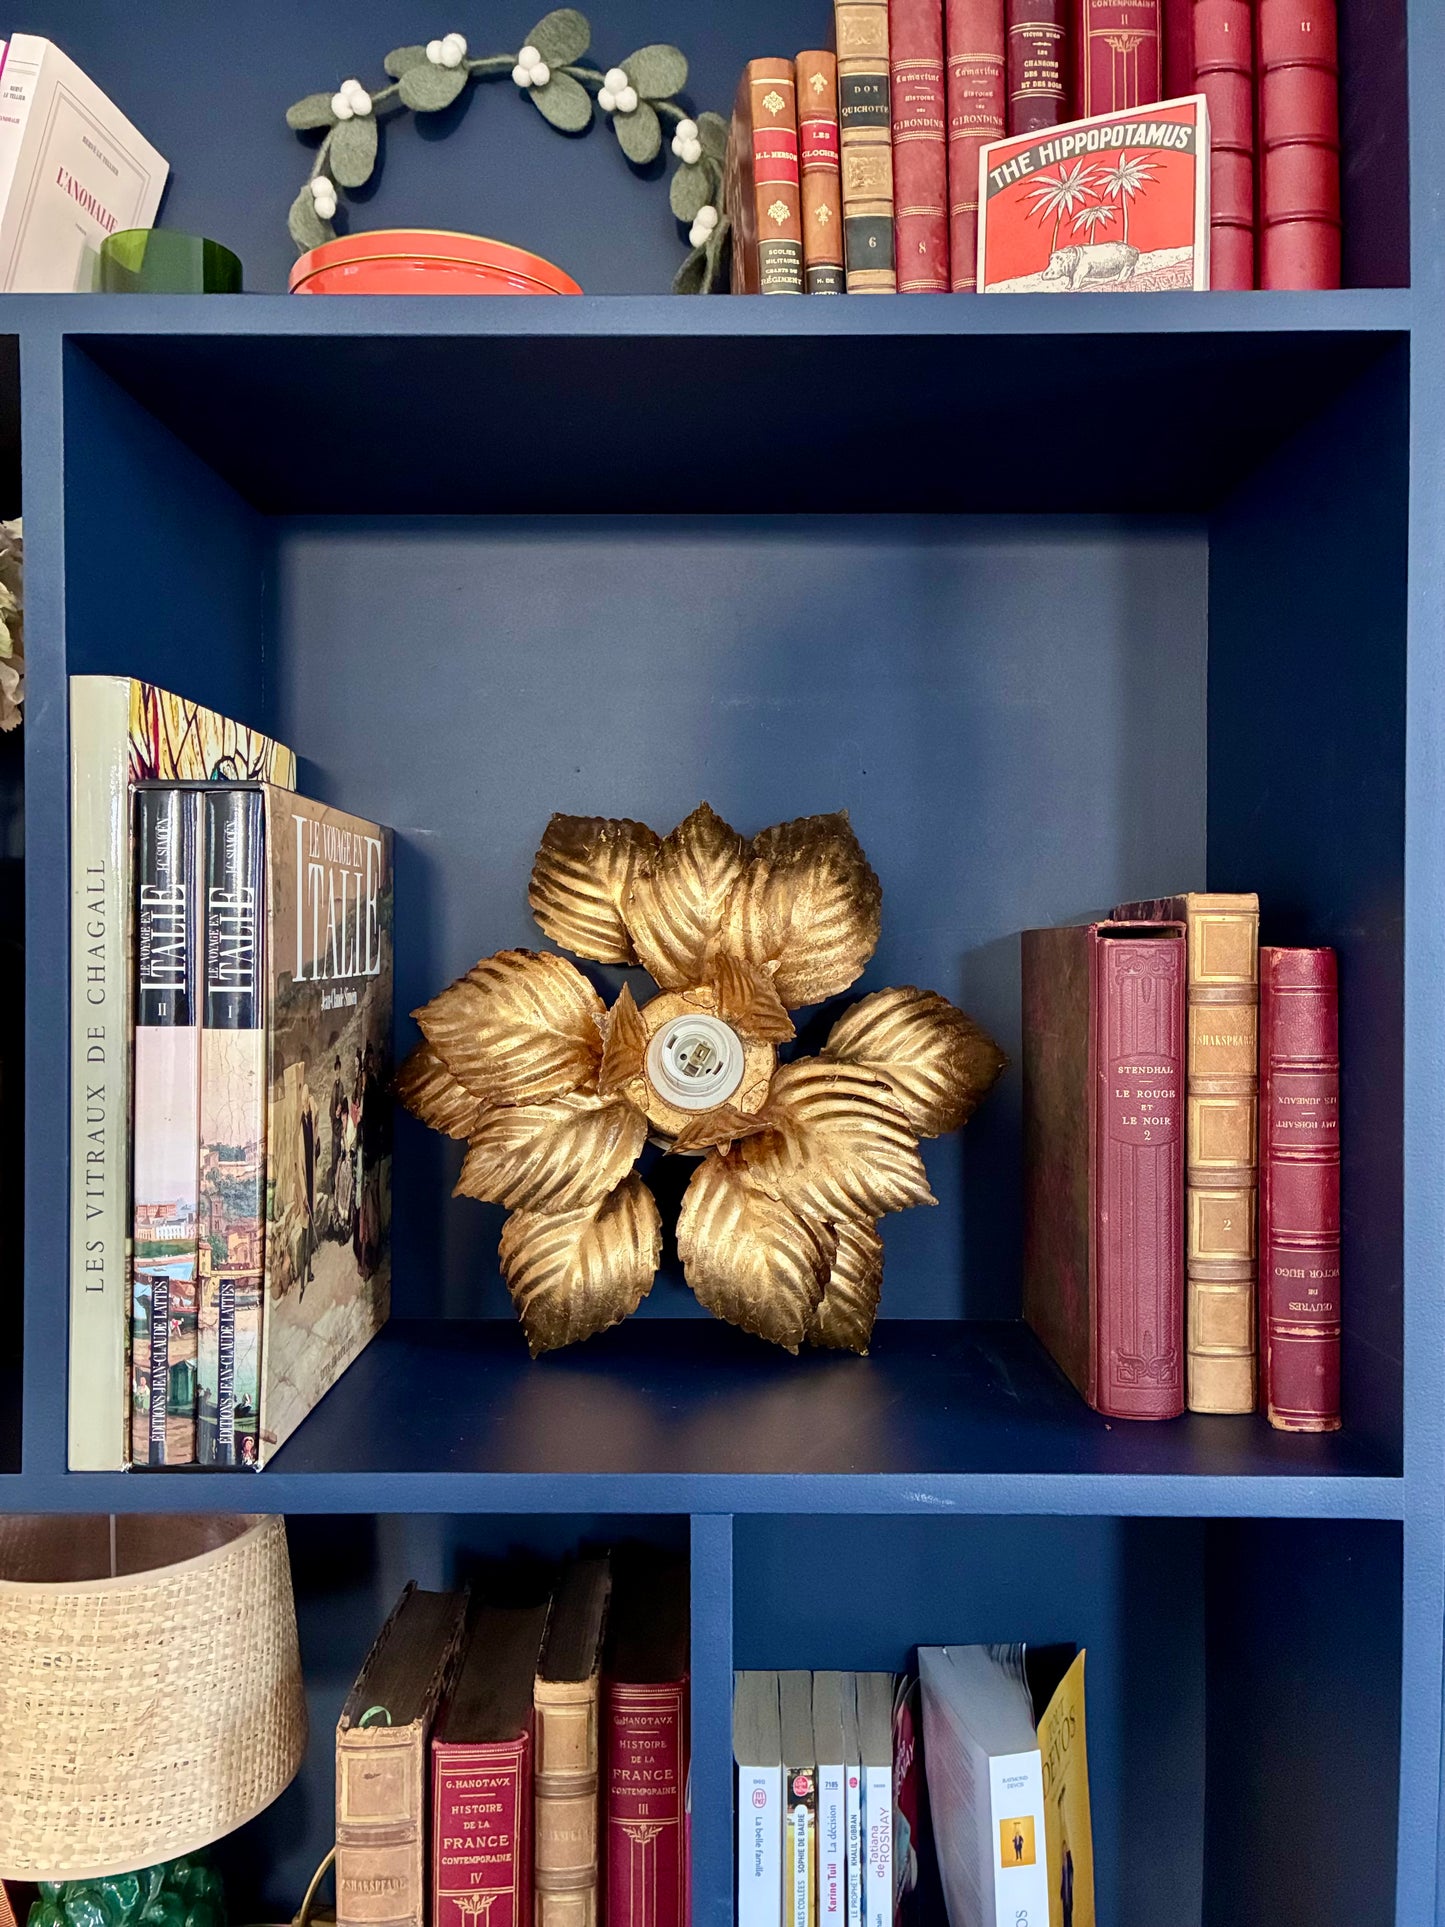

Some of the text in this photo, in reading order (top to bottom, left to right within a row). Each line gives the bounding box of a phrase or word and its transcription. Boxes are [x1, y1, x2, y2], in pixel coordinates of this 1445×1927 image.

[1121, 14, 1128, 25] II
[1223, 22, 1229, 32] I
[1301, 22, 1311, 32] II
[1024, 60, 1059, 68] CHANSONS
[854, 85, 879, 93] DON
[842, 105, 889, 117] QUICHOTTE
[893, 118, 944, 131] GIRONDINS
[952, 115, 1004, 127] GIRONDINS
[812, 131, 830, 139] LES
[990, 123, 1192, 189] THE HIPPOPOTAMUS
[868, 236, 877, 248] 6
[761, 275, 802, 285] RÉGIMENT
[307, 819, 363, 868] LE VOYAGE EN
[292, 814, 381, 982] ITALIE
[140, 884, 186, 994] ITALIE
[140, 911, 151, 977] LE VOYAGE EN
[208, 887, 255, 997] ITALIE
[208, 914, 219, 980] LE VOYAGE EN
[158, 1002, 167, 1016] II
[228, 1005, 233, 1019] I
[86, 860, 106, 1293] LES VITRAUX DE CHAGALL
[1118, 1066, 1173, 1074] STENDHAL
[1115, 1090, 1176, 1098] LE ROUGE
[1278, 1096, 1321, 1105] JUMEAUX
[1122, 1117, 1171, 1125] LE NOIR
[1144, 1130, 1151, 1140] 2
[1223, 1219, 1232, 1231] 2
[1275, 1266, 1340, 1279] VICTOR HUGO
[152, 1320, 168, 1396] JEAN-CLAUDE
[219, 1323, 234, 1397] JEAN-CLAUDE
[150, 1396, 167, 1442] ÉDITIONS
[218, 1398, 234, 1444] ÉDITIONS
[620, 1740, 667, 1749] HISTOIRE
[631, 1756, 641, 1764] DE
[613, 1768, 674, 1781] FRANCE
[611, 1786, 677, 1796] CONTEMPORAINE
[451, 1803, 503, 1815] HISTOIRE
[638, 1803, 649, 1815] III
[463, 1820, 490, 1830] DE LA
[827, 1805, 837, 1853] La décision
[443, 1835, 510, 1850] FRANCE
[755, 1816, 764, 1877] La belle famille
[797, 1813, 805, 1873] SOPHIE DE BAERE
[870, 1825, 879, 1865] Tatiana
[875, 1807, 890, 1878] de ROSNAY
[442, 1853, 512, 1865] CONTEMPORAINE
[470, 1872, 483, 1885] IV
[827, 1863, 837, 1912] Karine Tuil
[851, 1910, 858, 1918] LE
